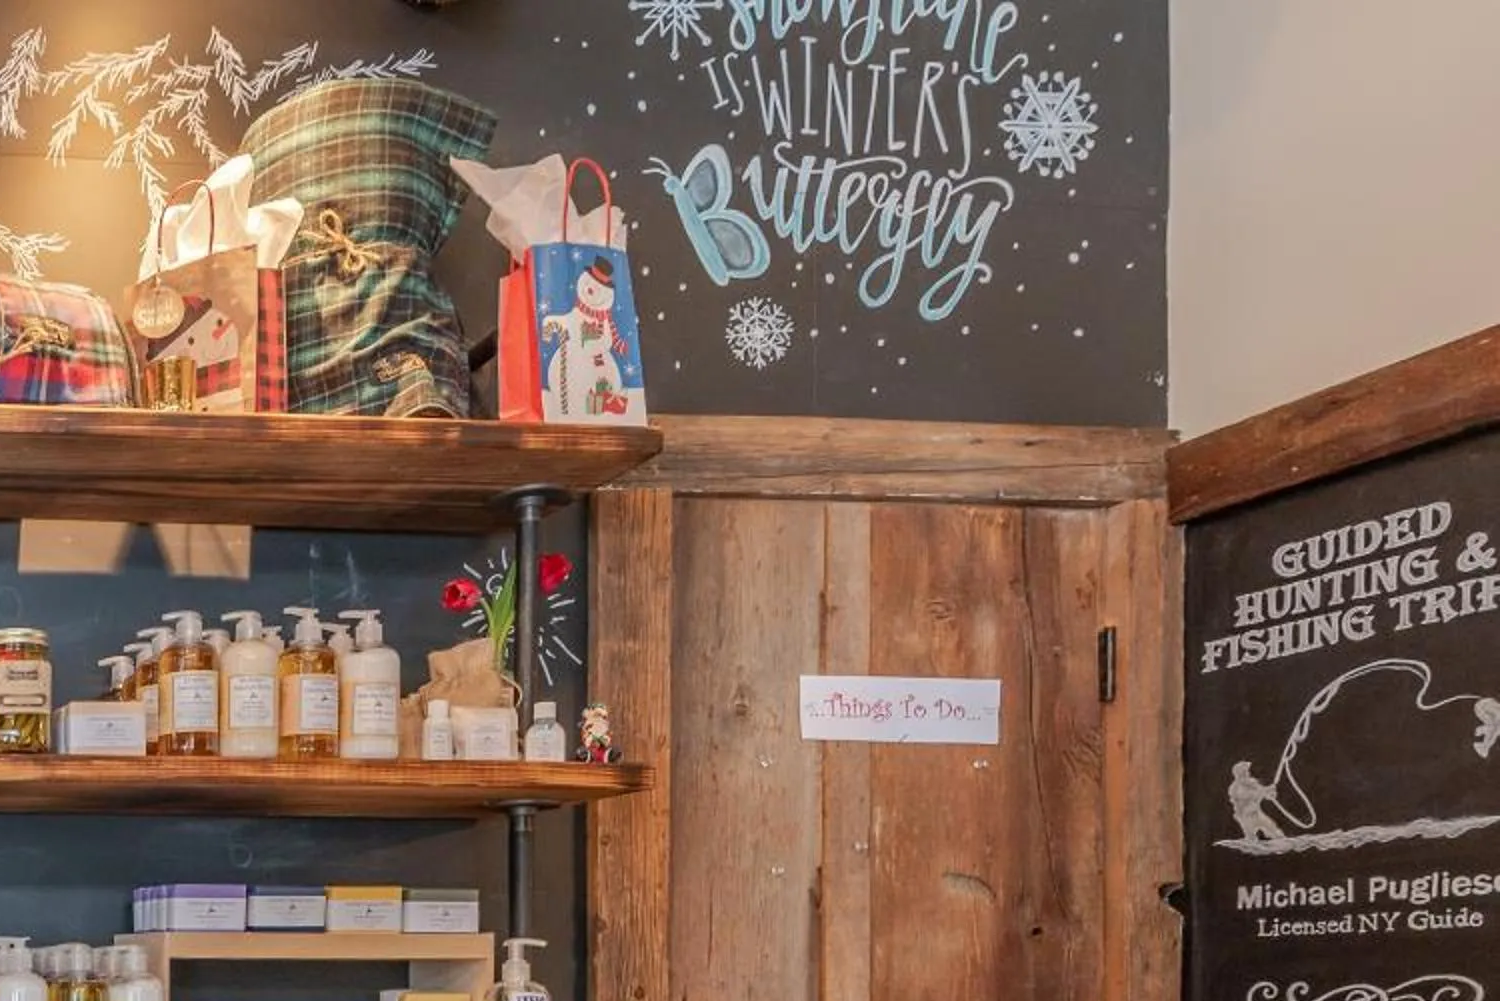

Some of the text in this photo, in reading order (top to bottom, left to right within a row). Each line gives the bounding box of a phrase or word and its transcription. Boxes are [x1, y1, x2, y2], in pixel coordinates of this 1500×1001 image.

[700, 36, 981, 179] IS WINTER'S
[1272, 502, 1451, 577] GUIDED
[1234, 532, 1498, 627] HUNTING &
[1201, 604, 1376, 674] FISHING
[899, 693, 927, 720] To
[1236, 877, 1355, 911] Michael
[1257, 907, 1484, 938] Licensed NY Guide
